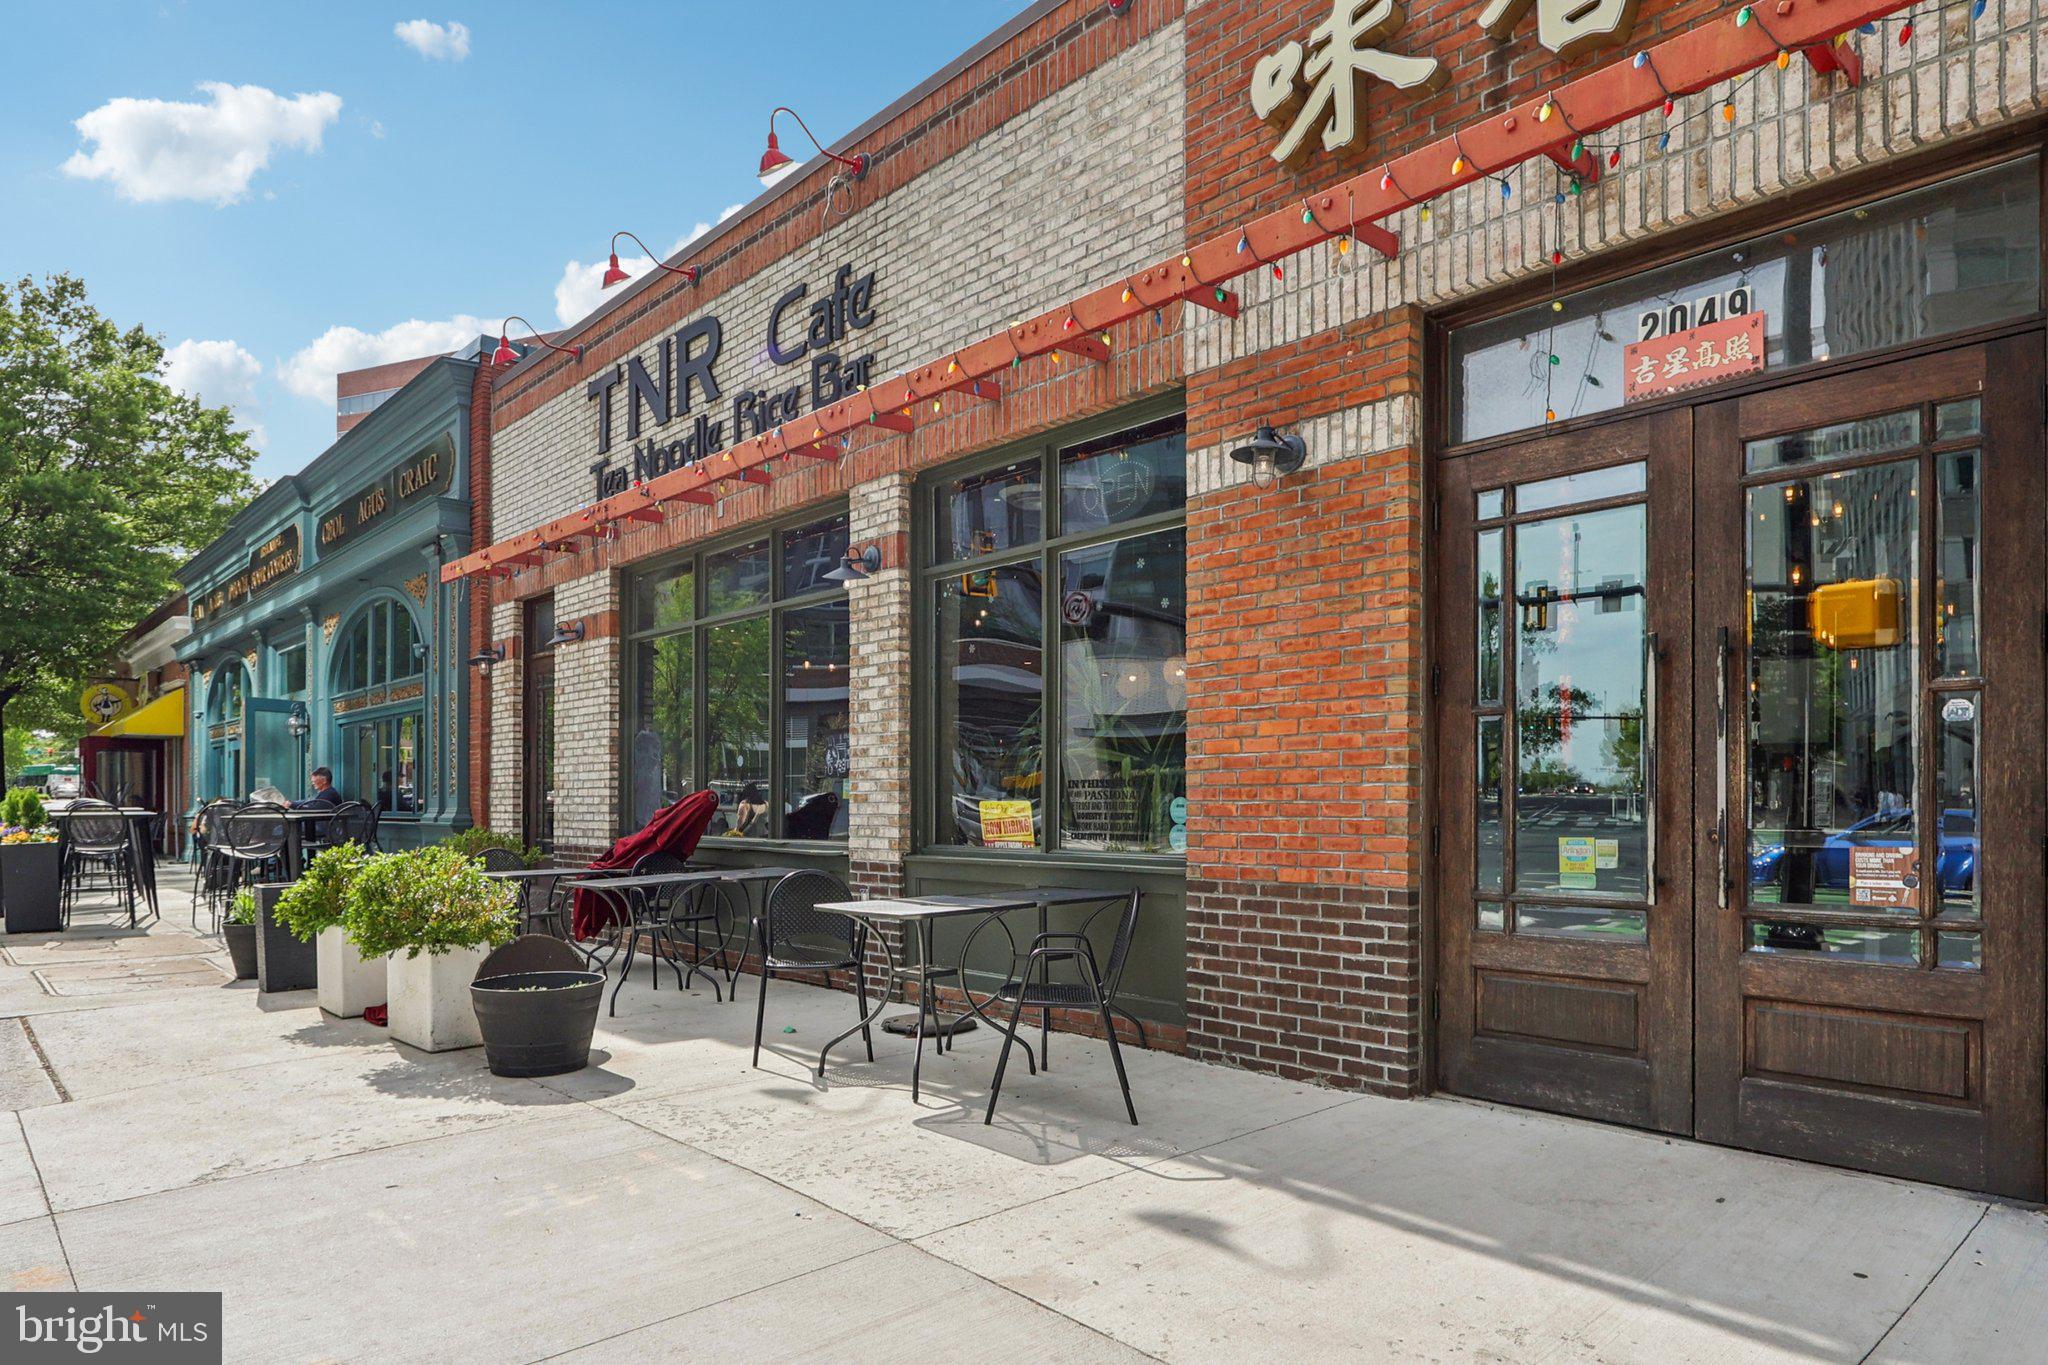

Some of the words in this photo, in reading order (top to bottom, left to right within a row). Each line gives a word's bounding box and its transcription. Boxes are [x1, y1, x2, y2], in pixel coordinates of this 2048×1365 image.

[1641, 288, 1749, 342] 2049
[588, 315, 722, 455] TNR
[767, 262, 877, 367] Cafe
[590, 457, 628, 501] Tea
[634, 413, 723, 482] Noodle
[733, 384, 800, 445] Rice
[811, 352, 875, 411] Bar
[358, 487, 388, 525] AGUS
[399, 453, 439, 499] CRAIC
[1083, 466, 1149, 513] OPEN
[1068, 780, 1079, 788] IN
[1084, 790, 1137, 800] PASSIONA
[985, 820, 1002, 835] NOW
[1003, 818, 1031, 834] HIRING
